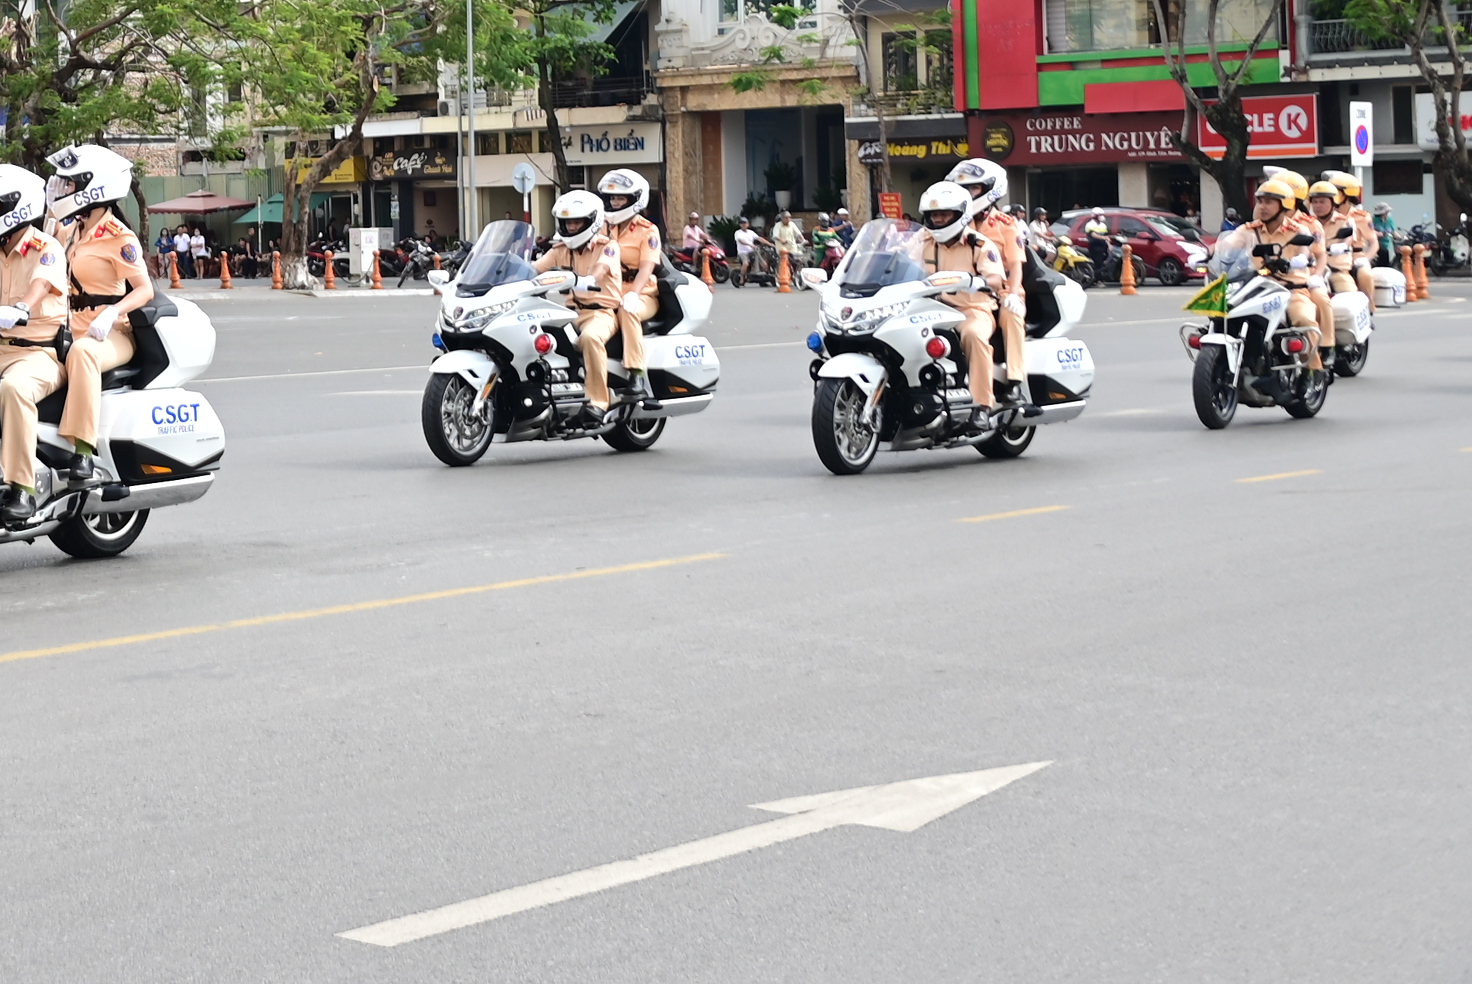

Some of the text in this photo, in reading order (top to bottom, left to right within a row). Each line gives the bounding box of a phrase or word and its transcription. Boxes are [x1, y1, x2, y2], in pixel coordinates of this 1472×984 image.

[1026, 117, 1082, 131] COFFEE
[1027, 132, 1095, 154] TRUNG
[1100, 125, 1180, 151] NGUYÊ
[393, 152, 428, 175] Café
[73, 185, 106, 207] CSGT
[3, 202, 34, 228] CSGT
[151, 403, 201, 425] C.S.G.T
[157, 424, 195, 435] TRAFFIC POLICE
